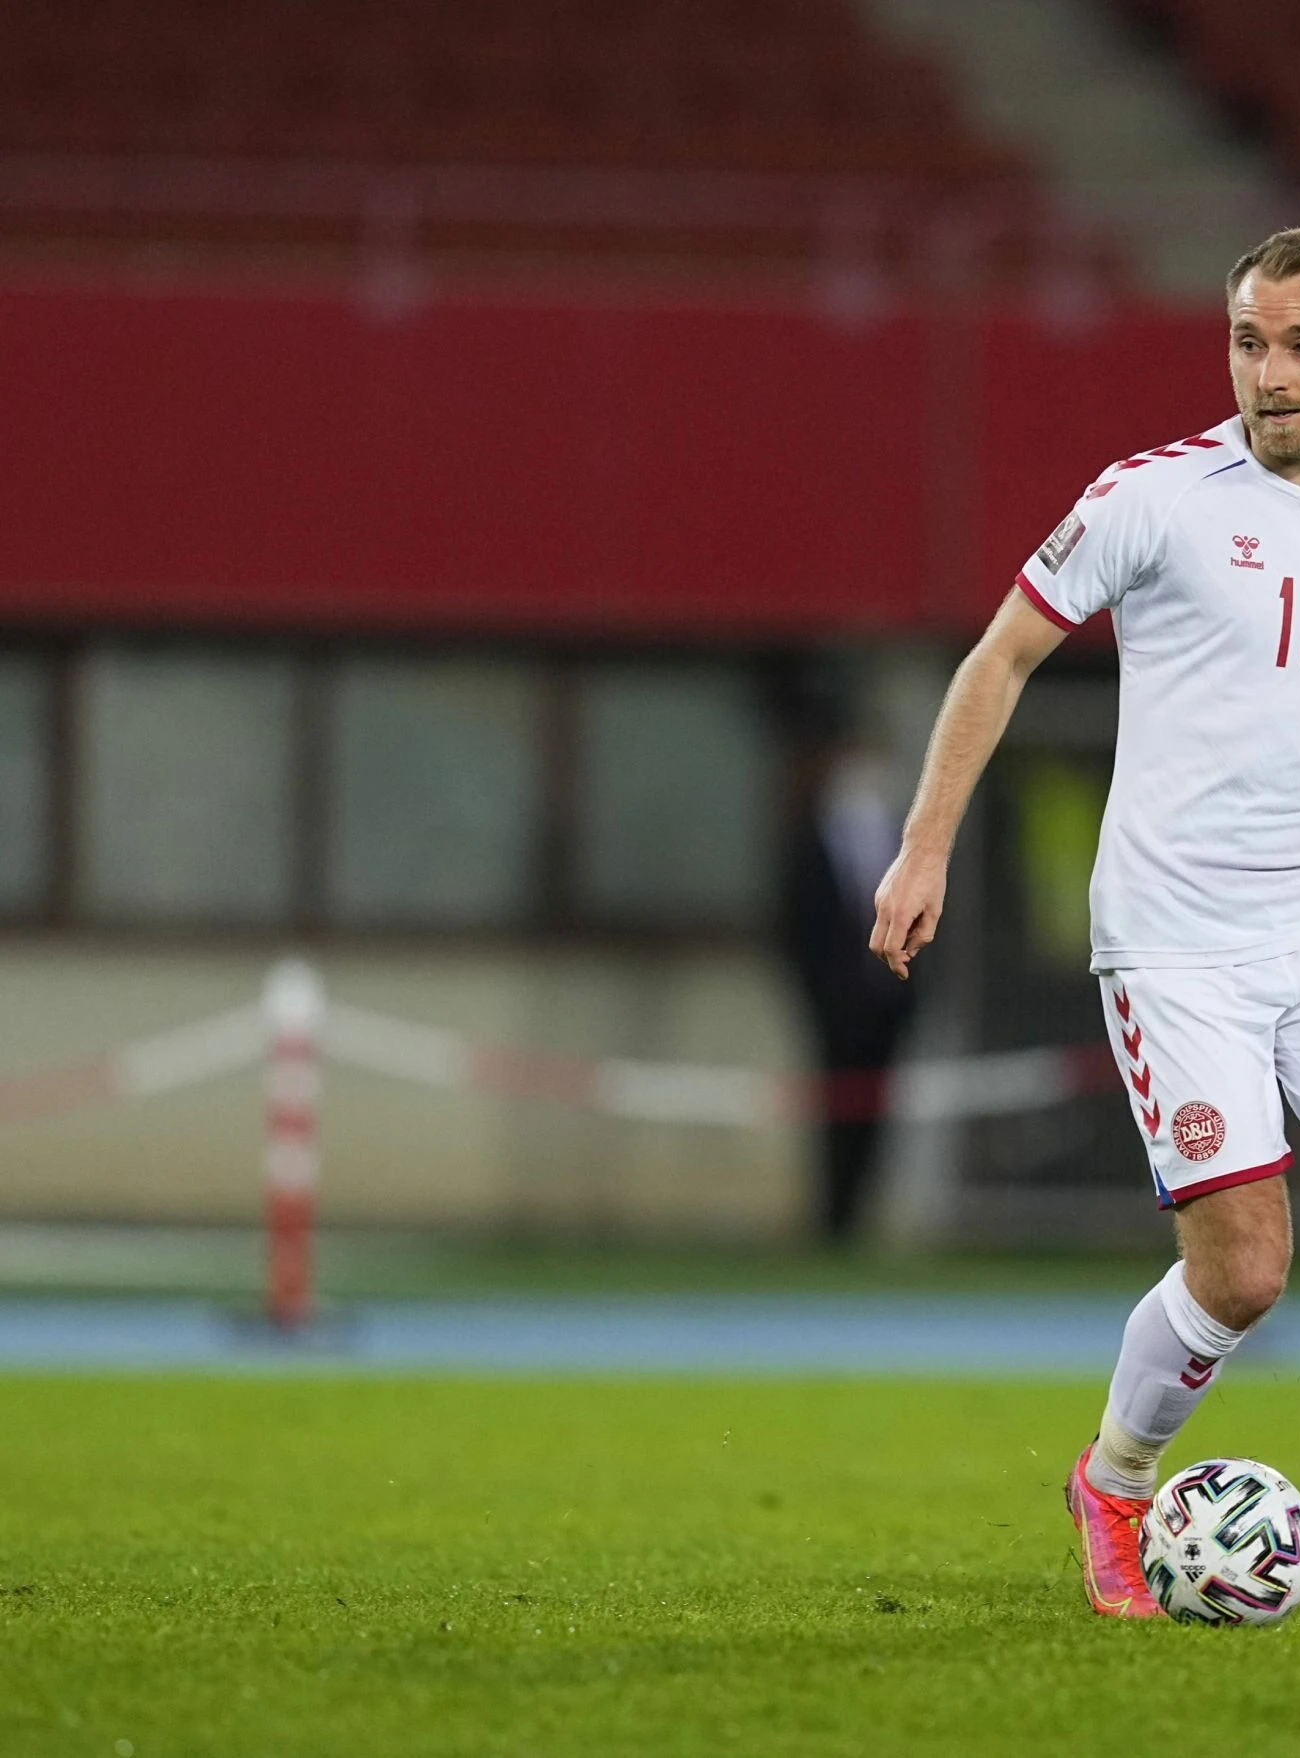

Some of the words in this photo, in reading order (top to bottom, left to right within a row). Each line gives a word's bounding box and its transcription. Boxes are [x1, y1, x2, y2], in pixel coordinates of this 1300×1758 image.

[1230, 557, 1264, 570] hummel
[1173, 1126, 1190, 1157] DANSK
[1180, 1120, 1214, 1143] DBU
[1213, 1116, 1225, 1148] UNION
[1192, 1149, 1215, 1160] 1889
